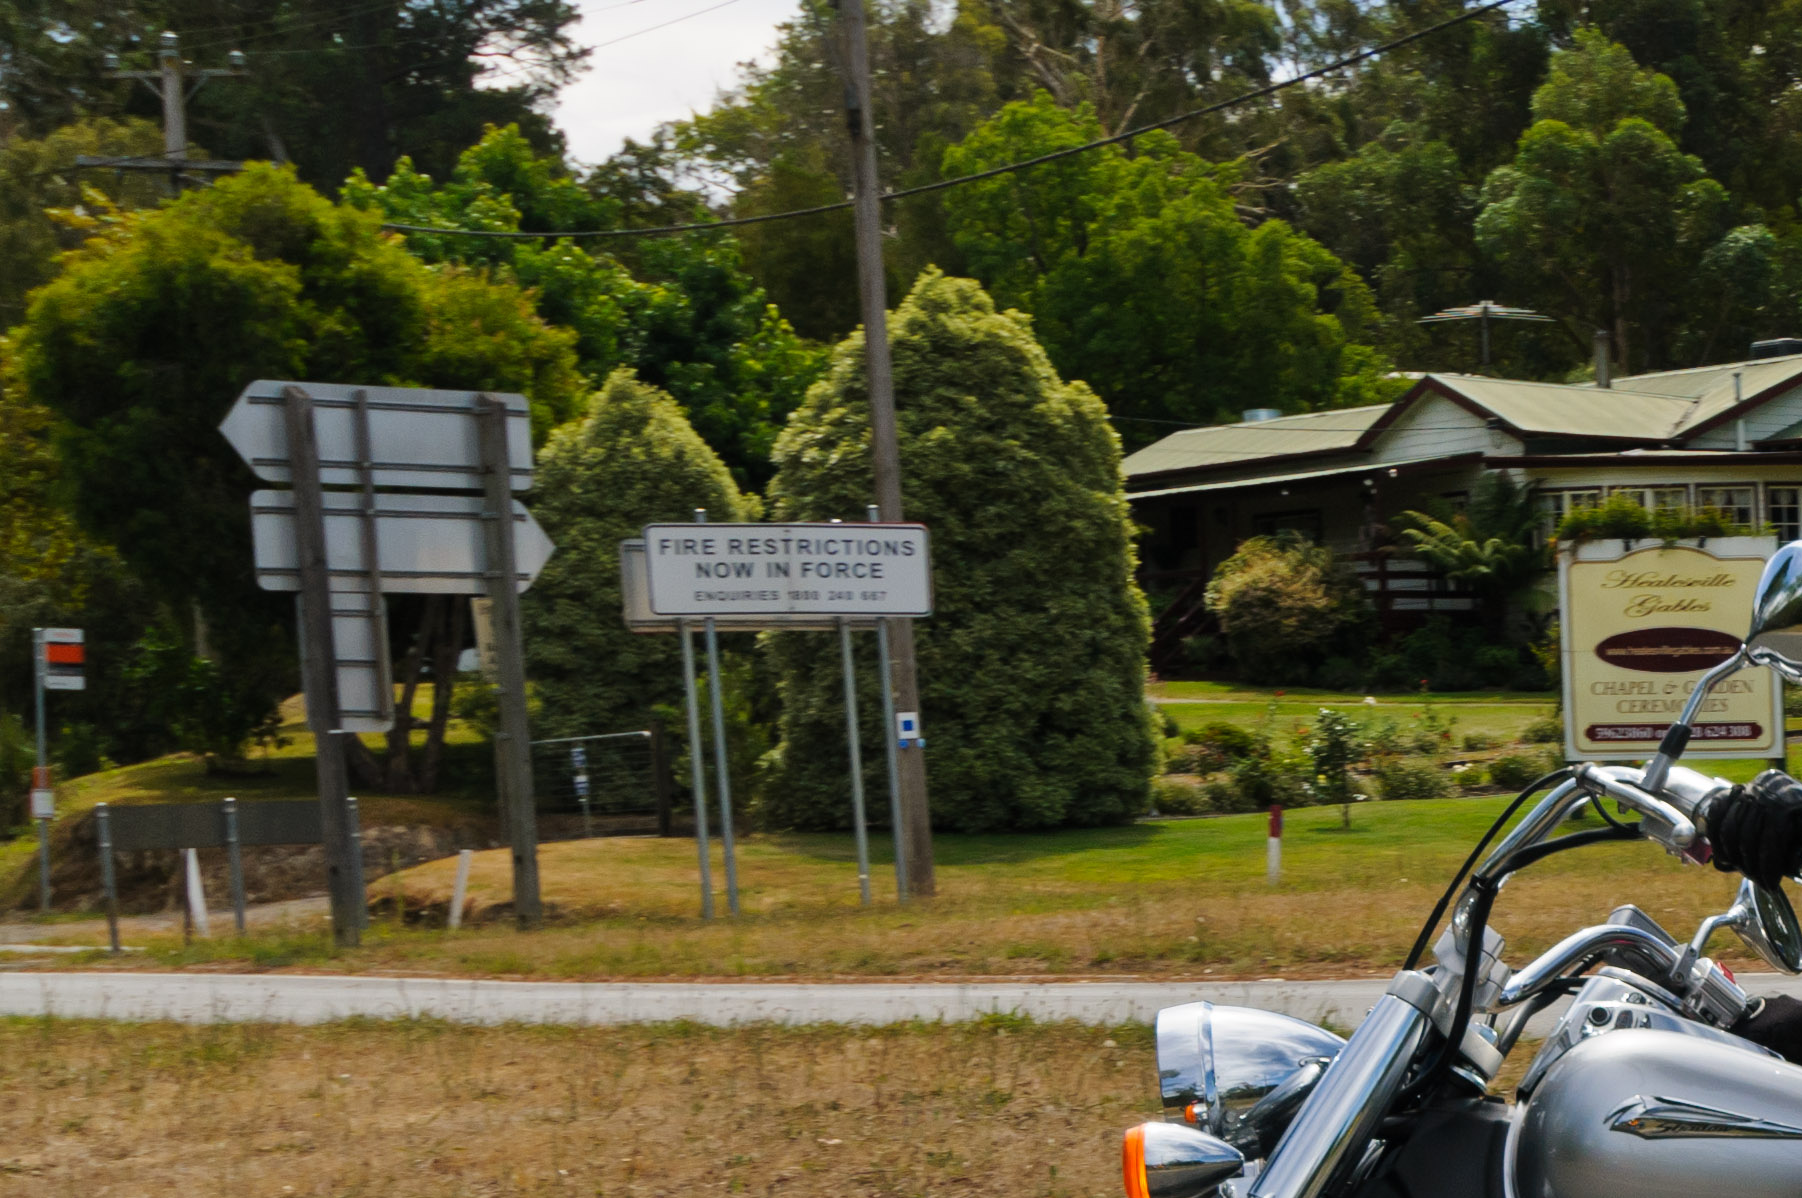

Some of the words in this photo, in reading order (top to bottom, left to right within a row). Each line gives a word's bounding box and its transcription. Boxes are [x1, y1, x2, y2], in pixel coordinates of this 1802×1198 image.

[659, 538, 716, 555] FIRE
[728, 538, 915, 556] RESTRICTIONS
[695, 561, 754, 578] NOW
[766, 561, 791, 578] IN
[801, 561, 884, 578] FORCE
[1600, 569, 1737, 589] Healesville
[694, 590, 779, 601] ENQUIRIES
[1624, 593, 1712, 618] Gables
[1590, 681, 1657, 696] CHAPEL
[1682, 679, 1754, 695] GDEN
